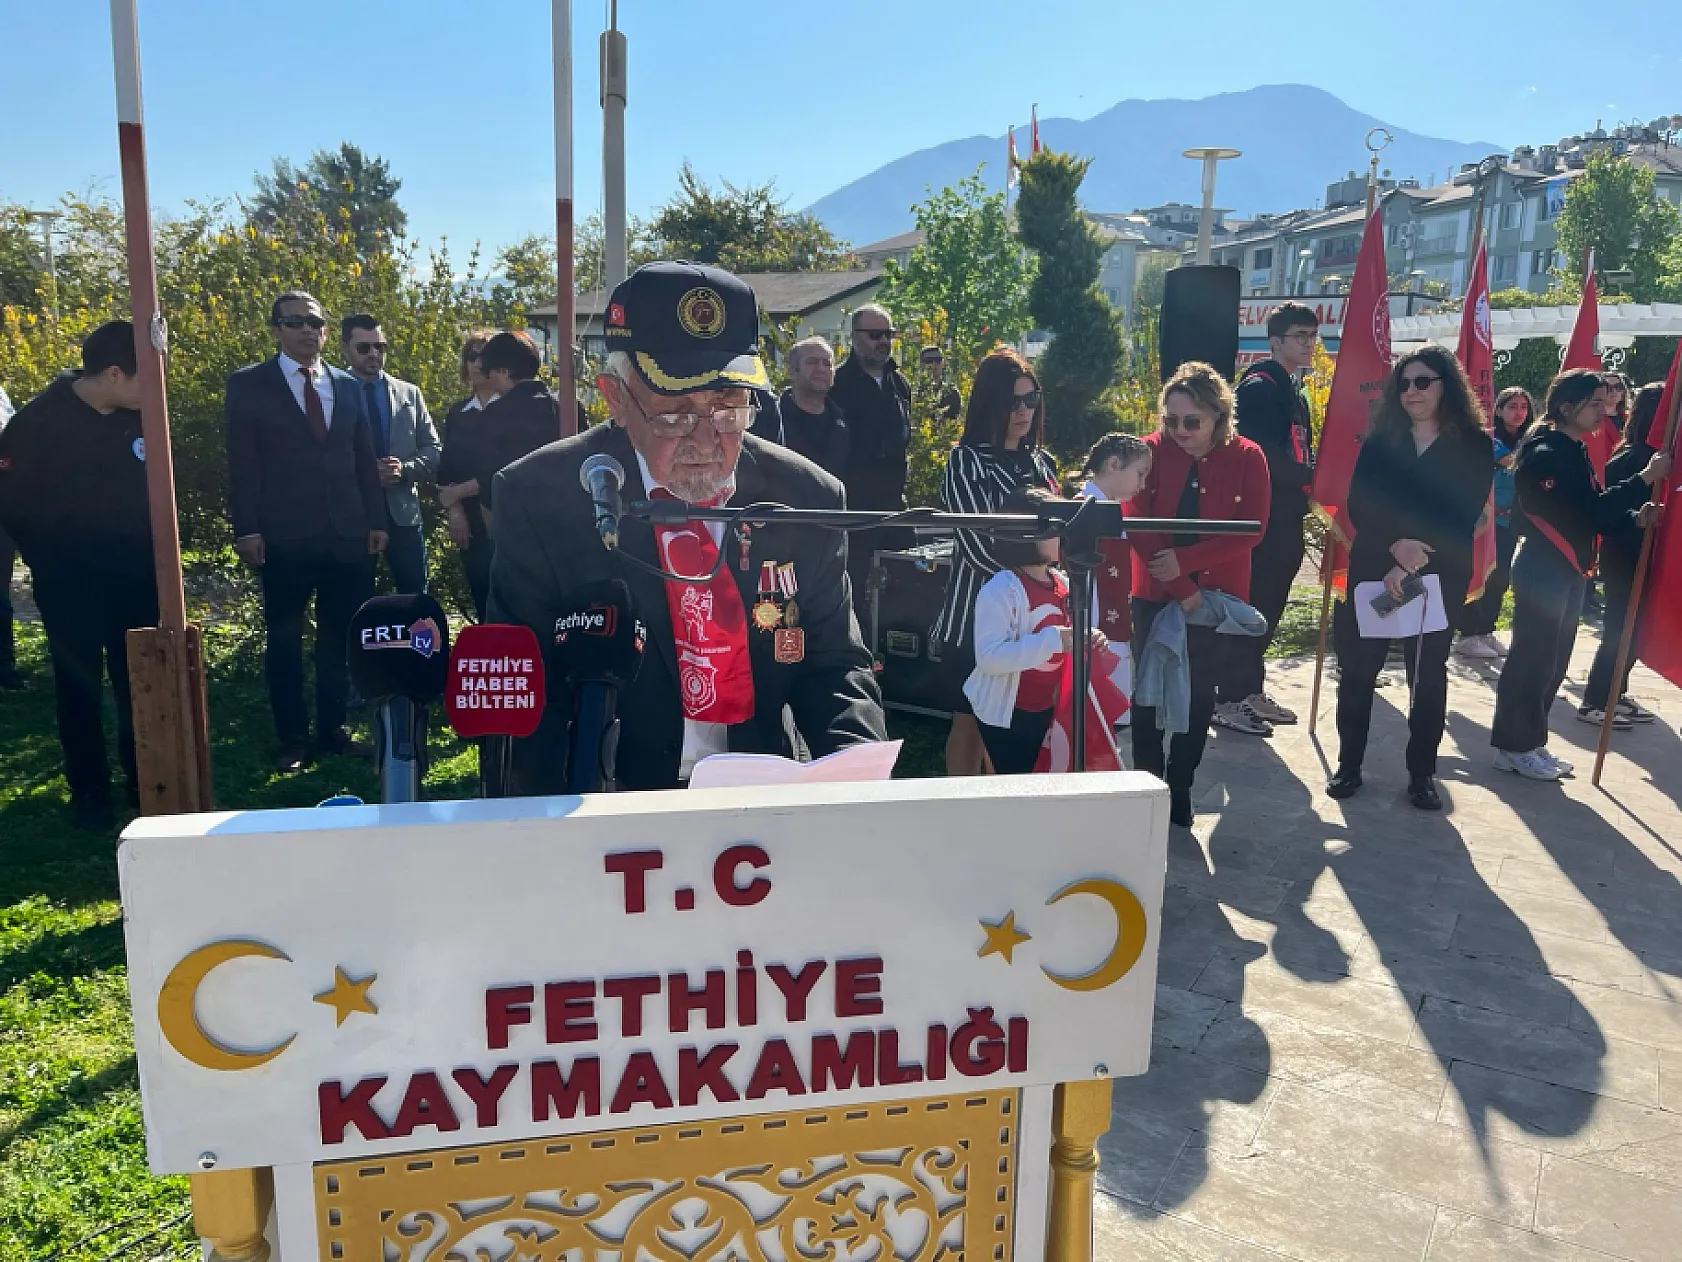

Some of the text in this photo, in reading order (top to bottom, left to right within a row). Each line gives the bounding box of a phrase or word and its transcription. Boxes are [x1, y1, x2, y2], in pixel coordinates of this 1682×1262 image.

[554, 612, 605, 633] Fethiye
[361, 625, 432, 649] FRT tv
[457, 656, 534, 673] FETHİYE
[461, 677, 529, 692] HABER
[455, 691, 536, 710] BÜLTENİ
[486, 949, 885, 1049] FETHİYE
[318, 1008, 1029, 1145] KAYMAKAMLIĞI
